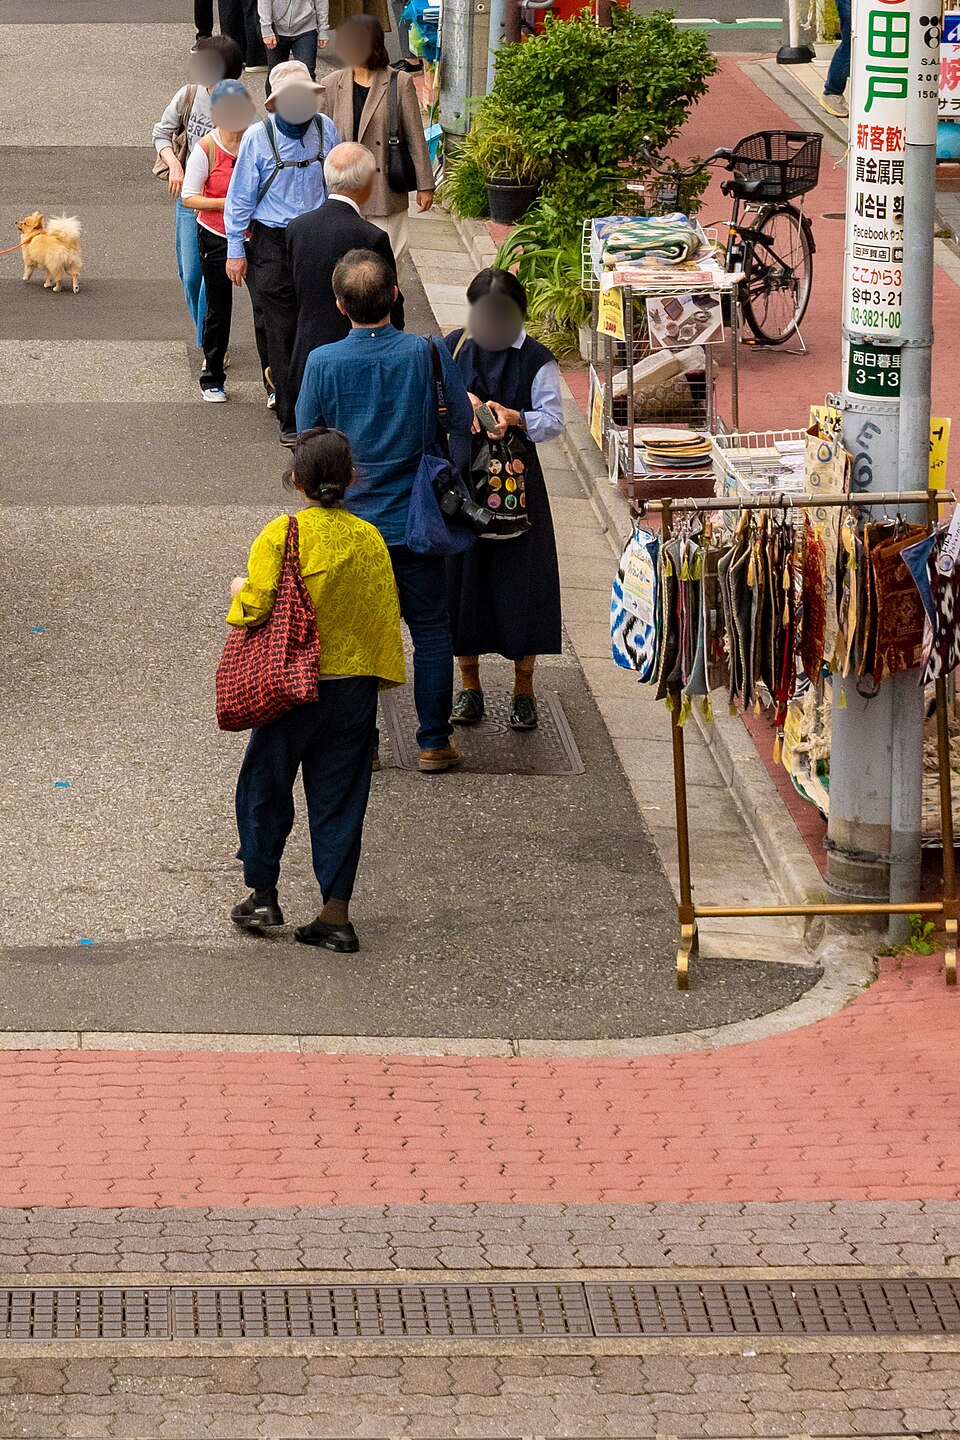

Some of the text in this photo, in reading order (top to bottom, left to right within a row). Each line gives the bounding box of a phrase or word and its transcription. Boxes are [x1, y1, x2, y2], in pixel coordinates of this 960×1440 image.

[863, 9, 911, 113] 田戸
[856, 122, 907, 153] 新客歓
[854, 191, 888, 220] 새손님
[853, 223, 889, 242] Facebook
[851, 265, 902, 287] ここから3
[851, 308, 903, 329] 03-3821-00
[852, 350, 902, 369] 西日暮里
[855, 369, 900, 387] 3-13
